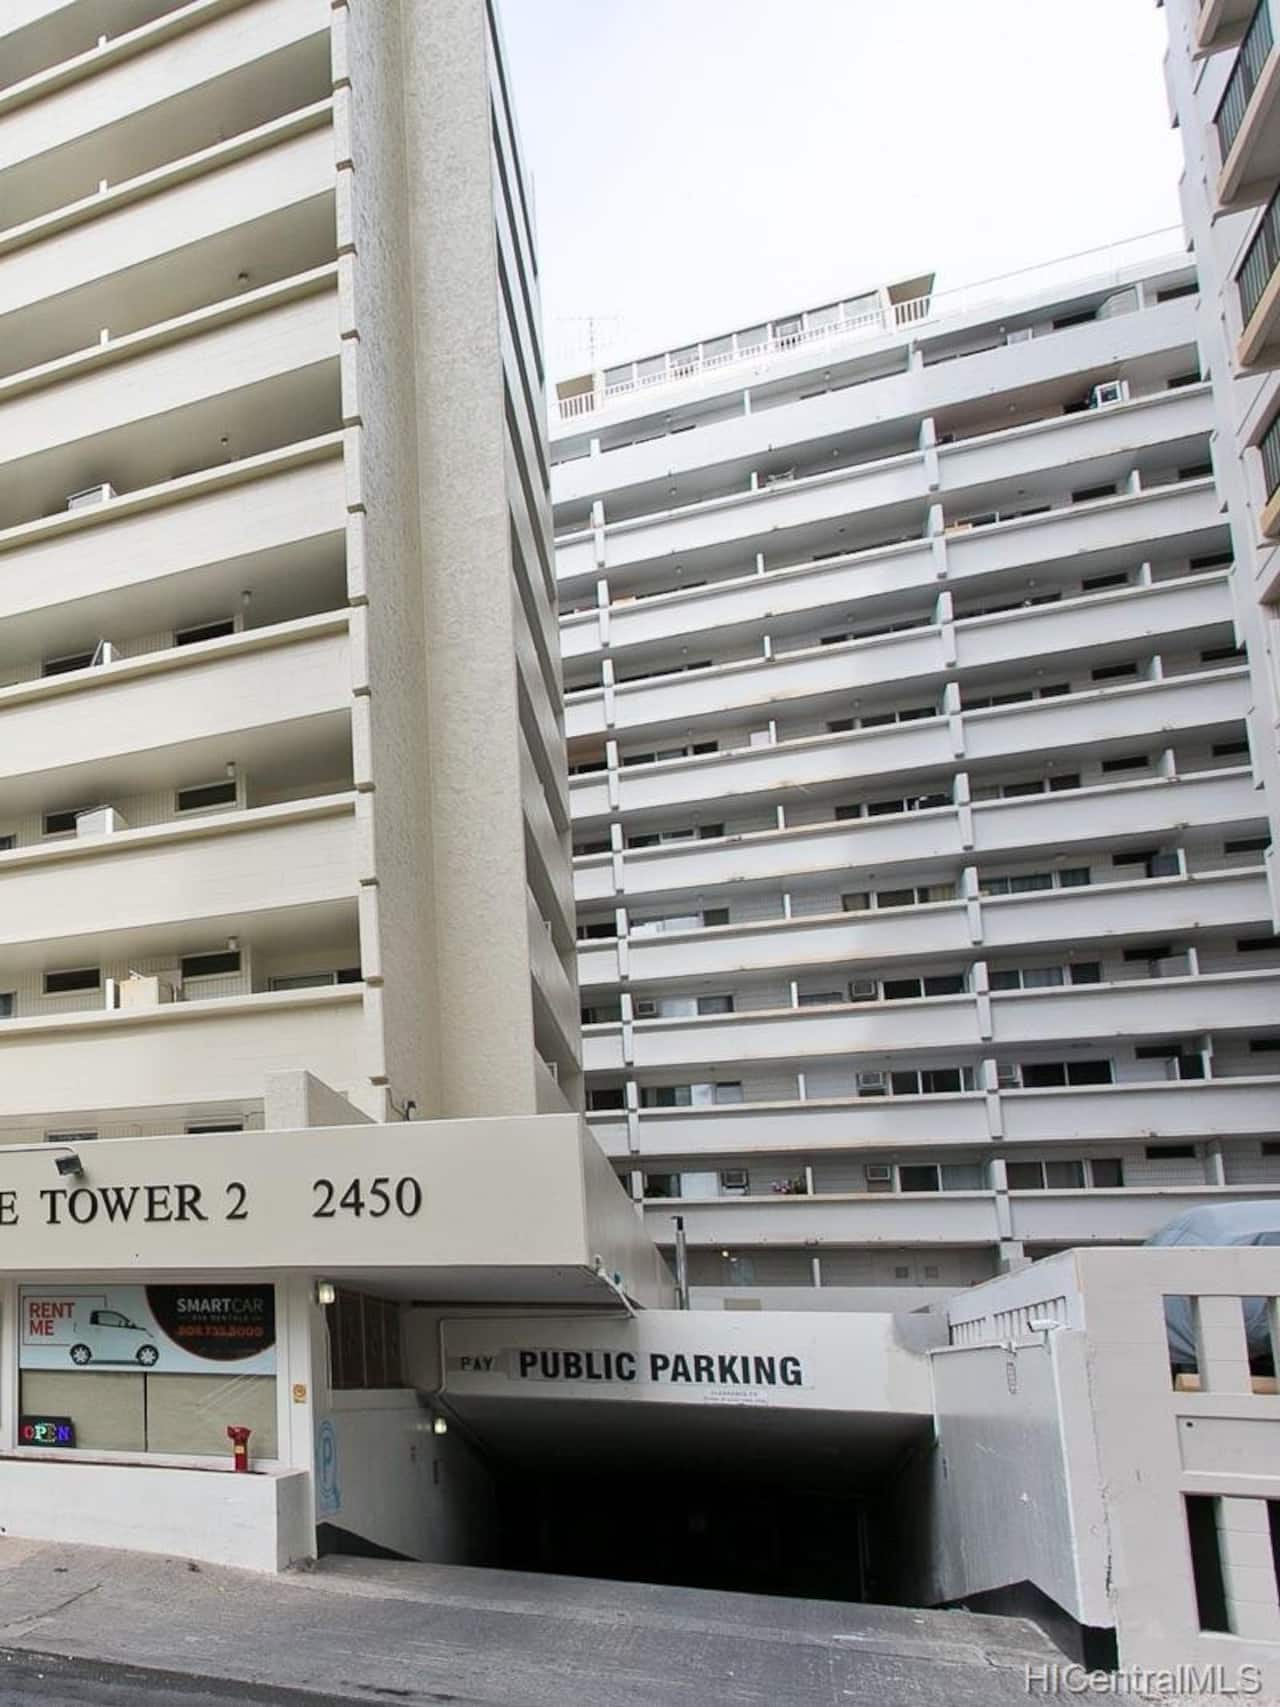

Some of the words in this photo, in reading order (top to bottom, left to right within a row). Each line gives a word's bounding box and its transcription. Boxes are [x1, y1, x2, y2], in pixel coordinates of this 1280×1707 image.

[39, 1184, 209, 1225] TOWER
[225, 1183, 249, 1220] 2
[312, 1176, 423, 1218] 2450
[29, 1302, 75, 1319] RENT
[176, 1298, 264, 1313] SMARTCAR
[29, 1320, 55, 1336] ME
[460, 1356, 494, 1371] PAY
[520, 1350, 636, 1382] PUBLIC
[649, 1353, 803, 1386] PARKING
[23, 1423, 71, 1442] OPEN
